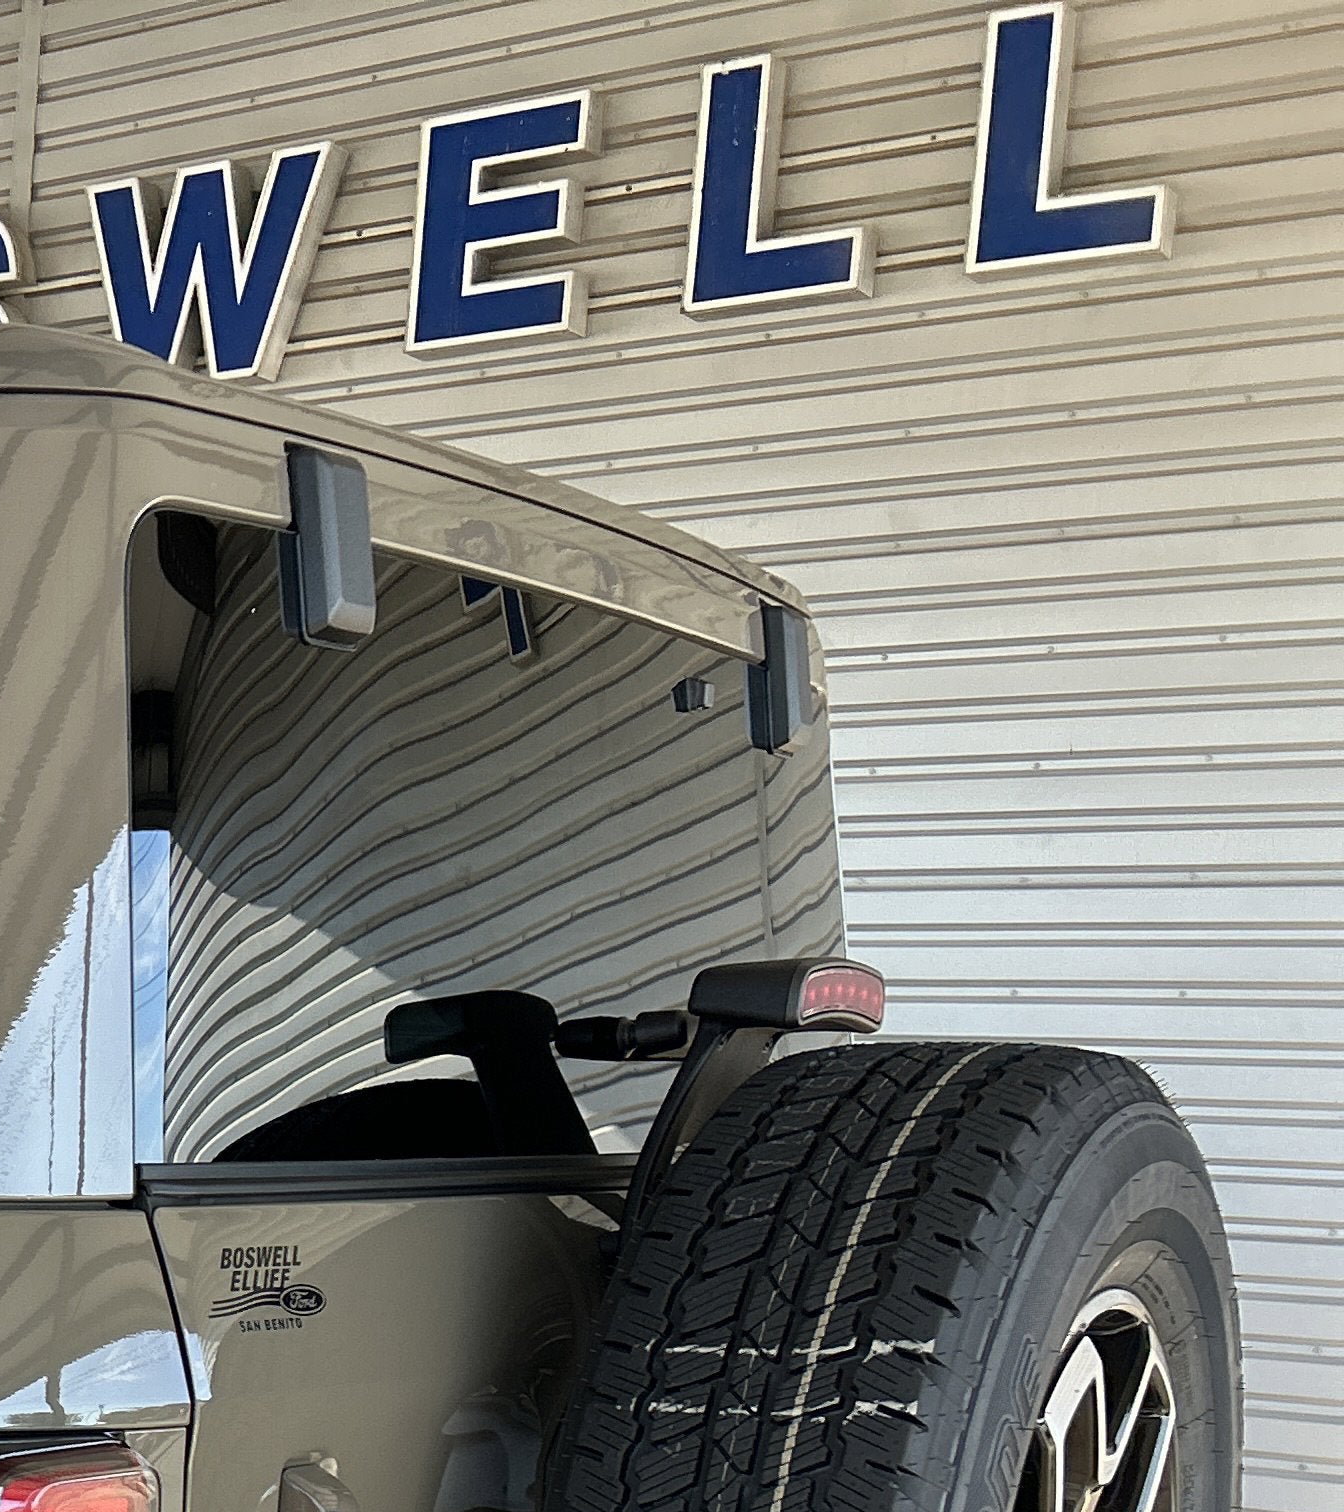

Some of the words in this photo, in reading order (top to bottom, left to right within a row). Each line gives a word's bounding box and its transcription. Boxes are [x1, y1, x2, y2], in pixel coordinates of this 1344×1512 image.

[220, 1244, 302, 1269] BOSWELL
[230, 1268, 291, 1292] ELLIFF
[239, 1320, 262, 1333] SAN
[264, 1317, 304, 1331] BENITO
